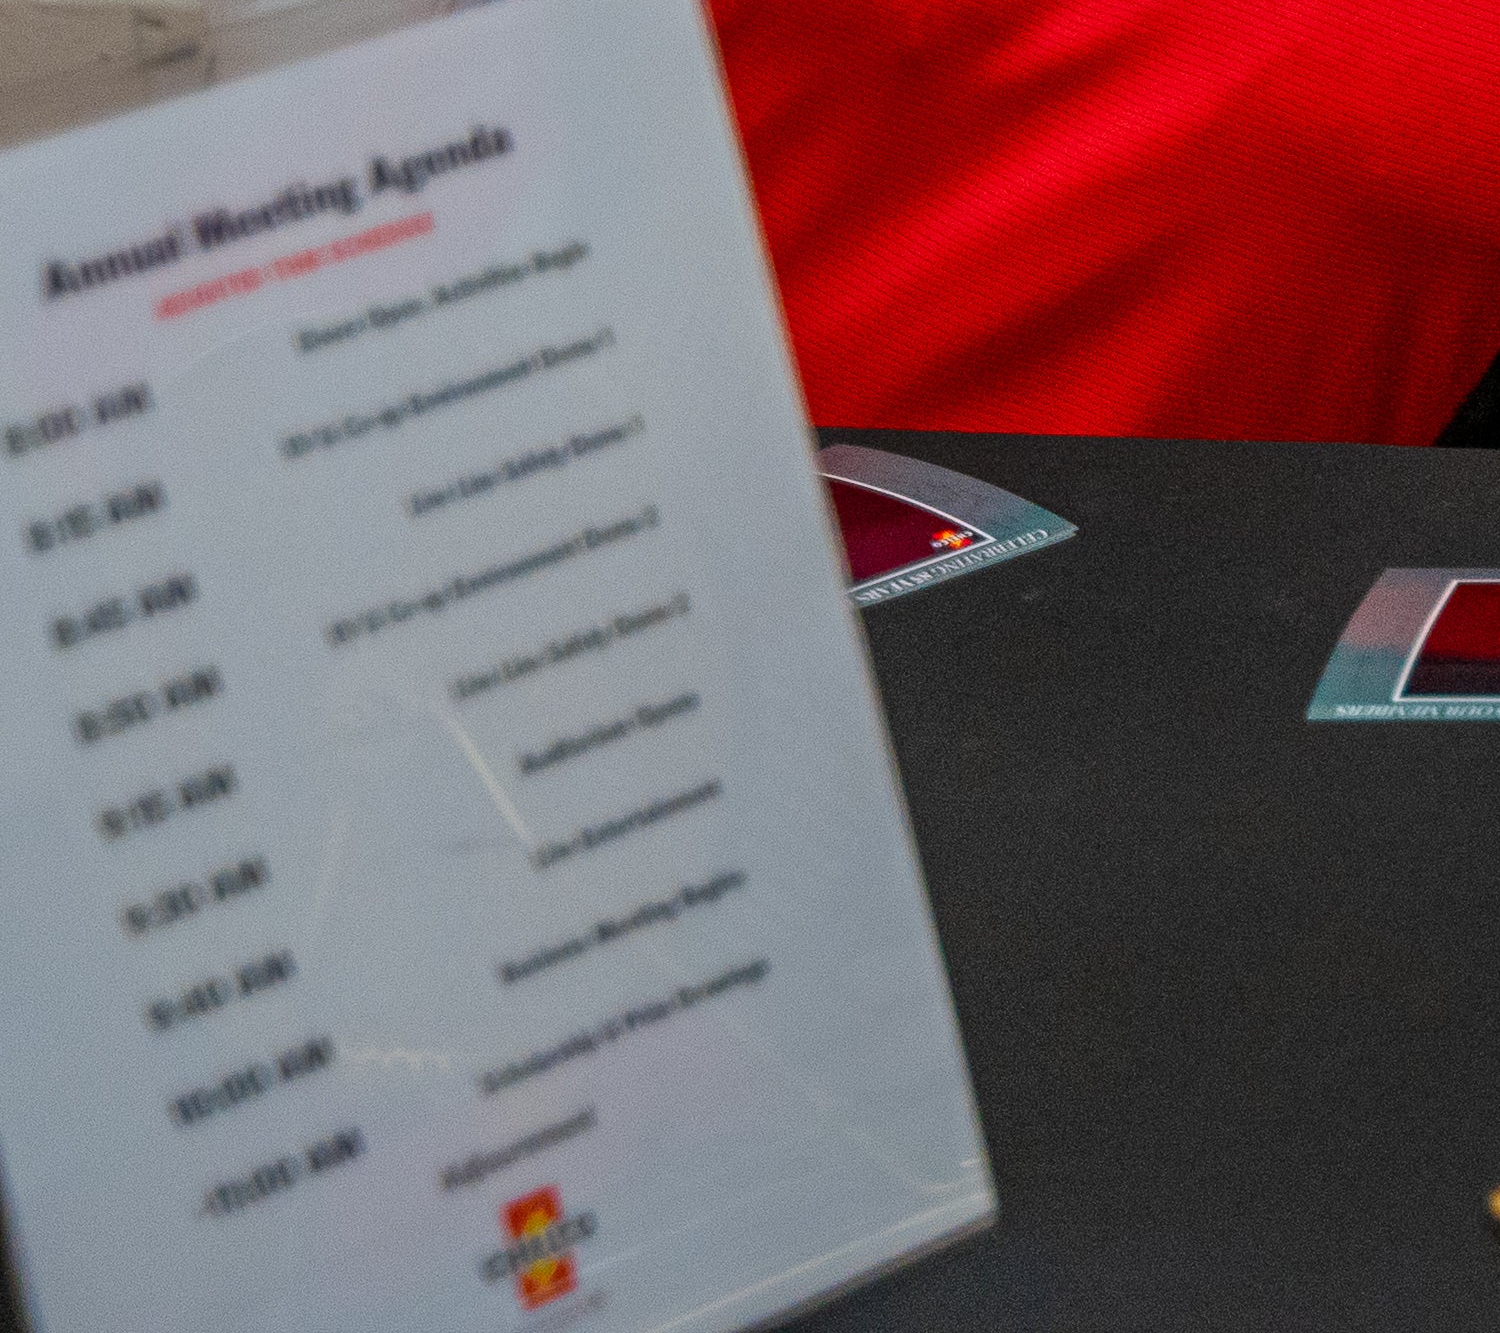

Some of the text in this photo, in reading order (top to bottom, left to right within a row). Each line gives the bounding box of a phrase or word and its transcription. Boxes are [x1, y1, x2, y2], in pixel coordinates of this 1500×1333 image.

[41, 126, 513, 302] Annual Meeting Agenda
[927, 525, 1049, 580] CELEBRATING
[854, 573, 914, 606] YEARS
